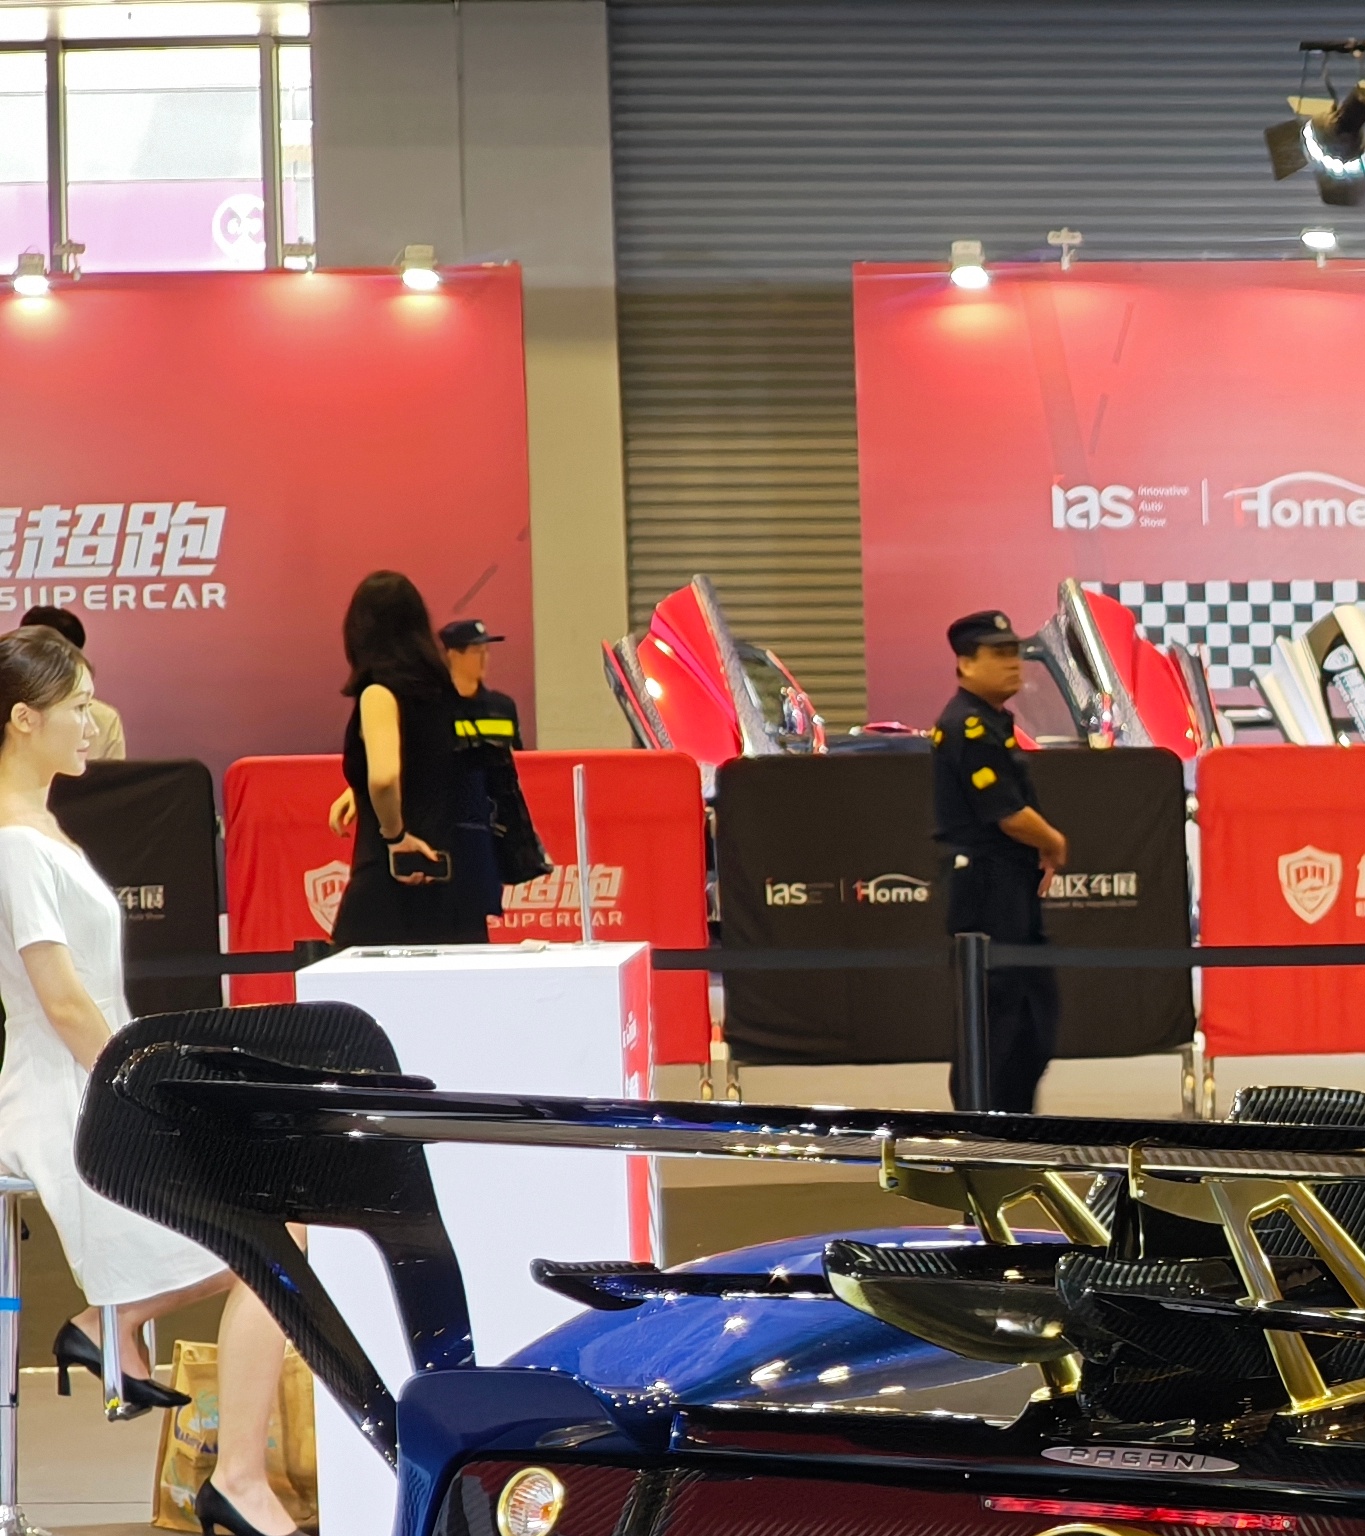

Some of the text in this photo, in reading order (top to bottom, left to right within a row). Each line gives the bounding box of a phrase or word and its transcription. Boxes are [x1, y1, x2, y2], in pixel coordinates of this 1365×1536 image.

[0, 501, 227, 579] 超跑
[765, 877, 809, 906] ias
[1066, 1448, 1208, 1471] PAGANI
